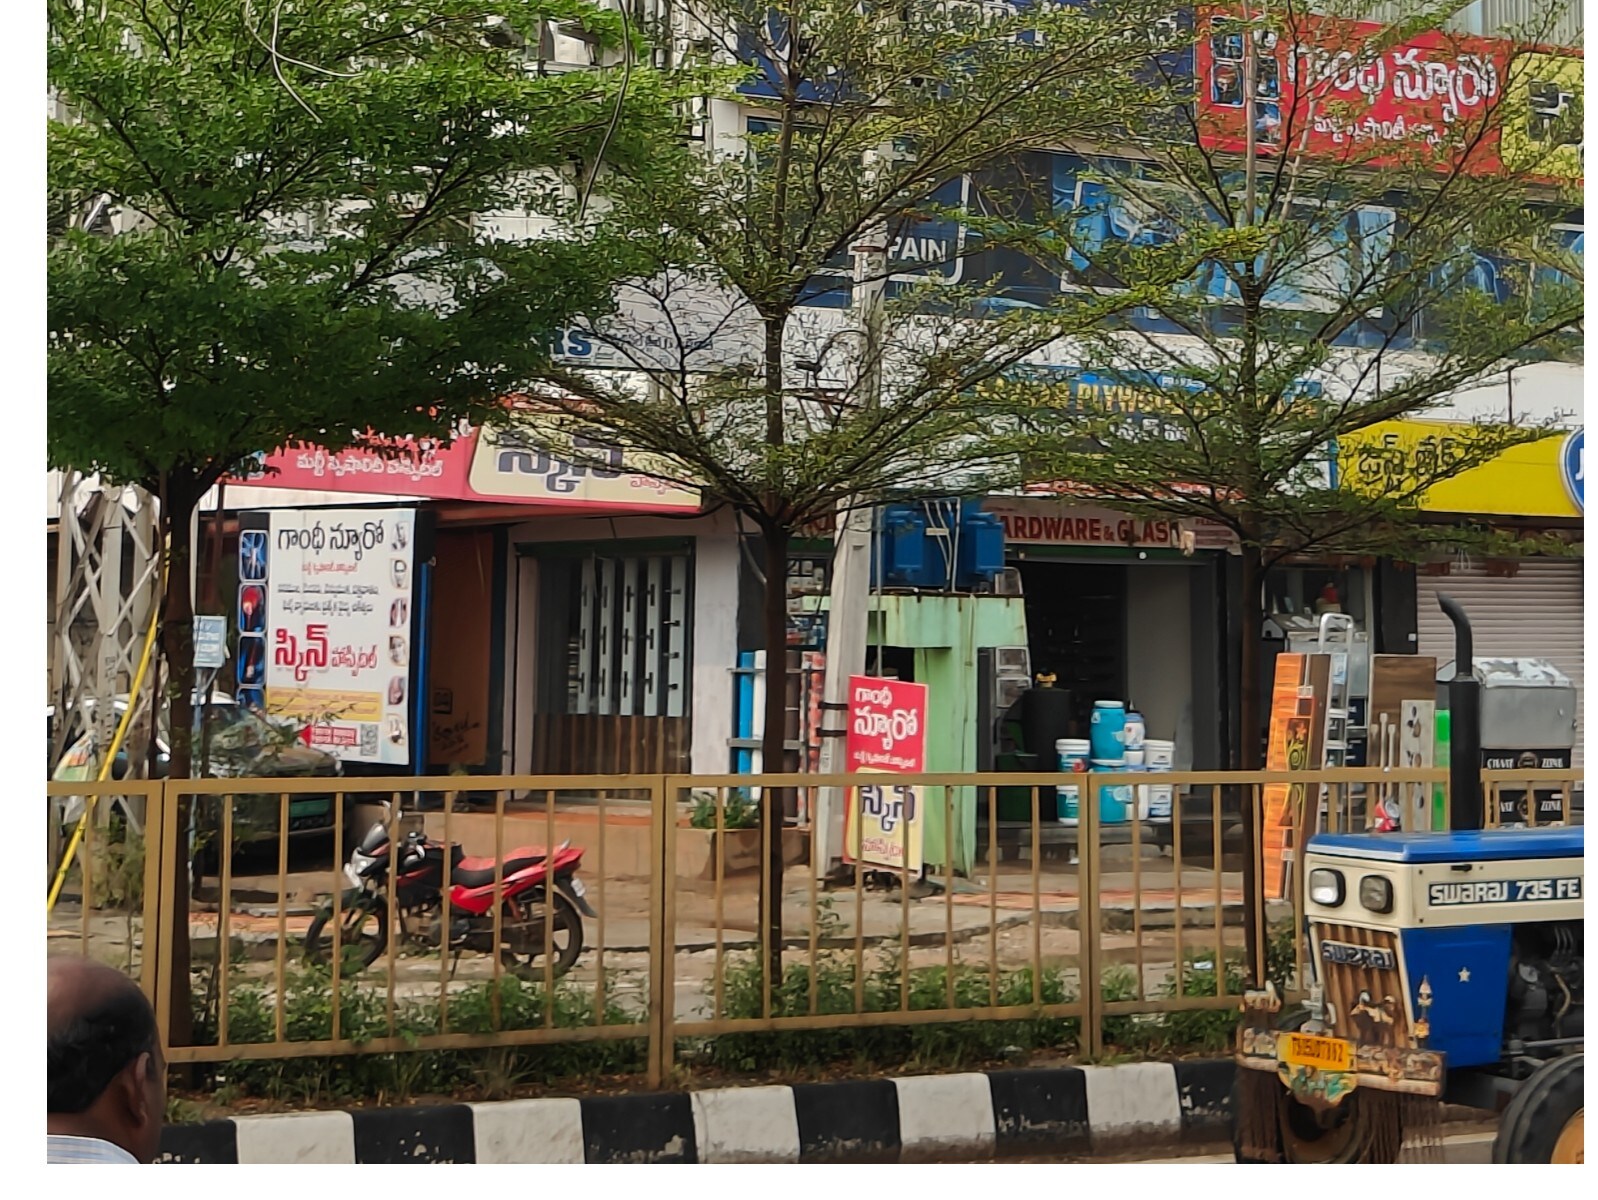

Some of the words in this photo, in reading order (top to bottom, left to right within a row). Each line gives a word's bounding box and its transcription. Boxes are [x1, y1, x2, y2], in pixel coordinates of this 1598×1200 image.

[1000, 514, 1101, 542] ARDWARE
[1516, 879, 1553, 900] 735
[1556, 877, 1580, 899] FE
